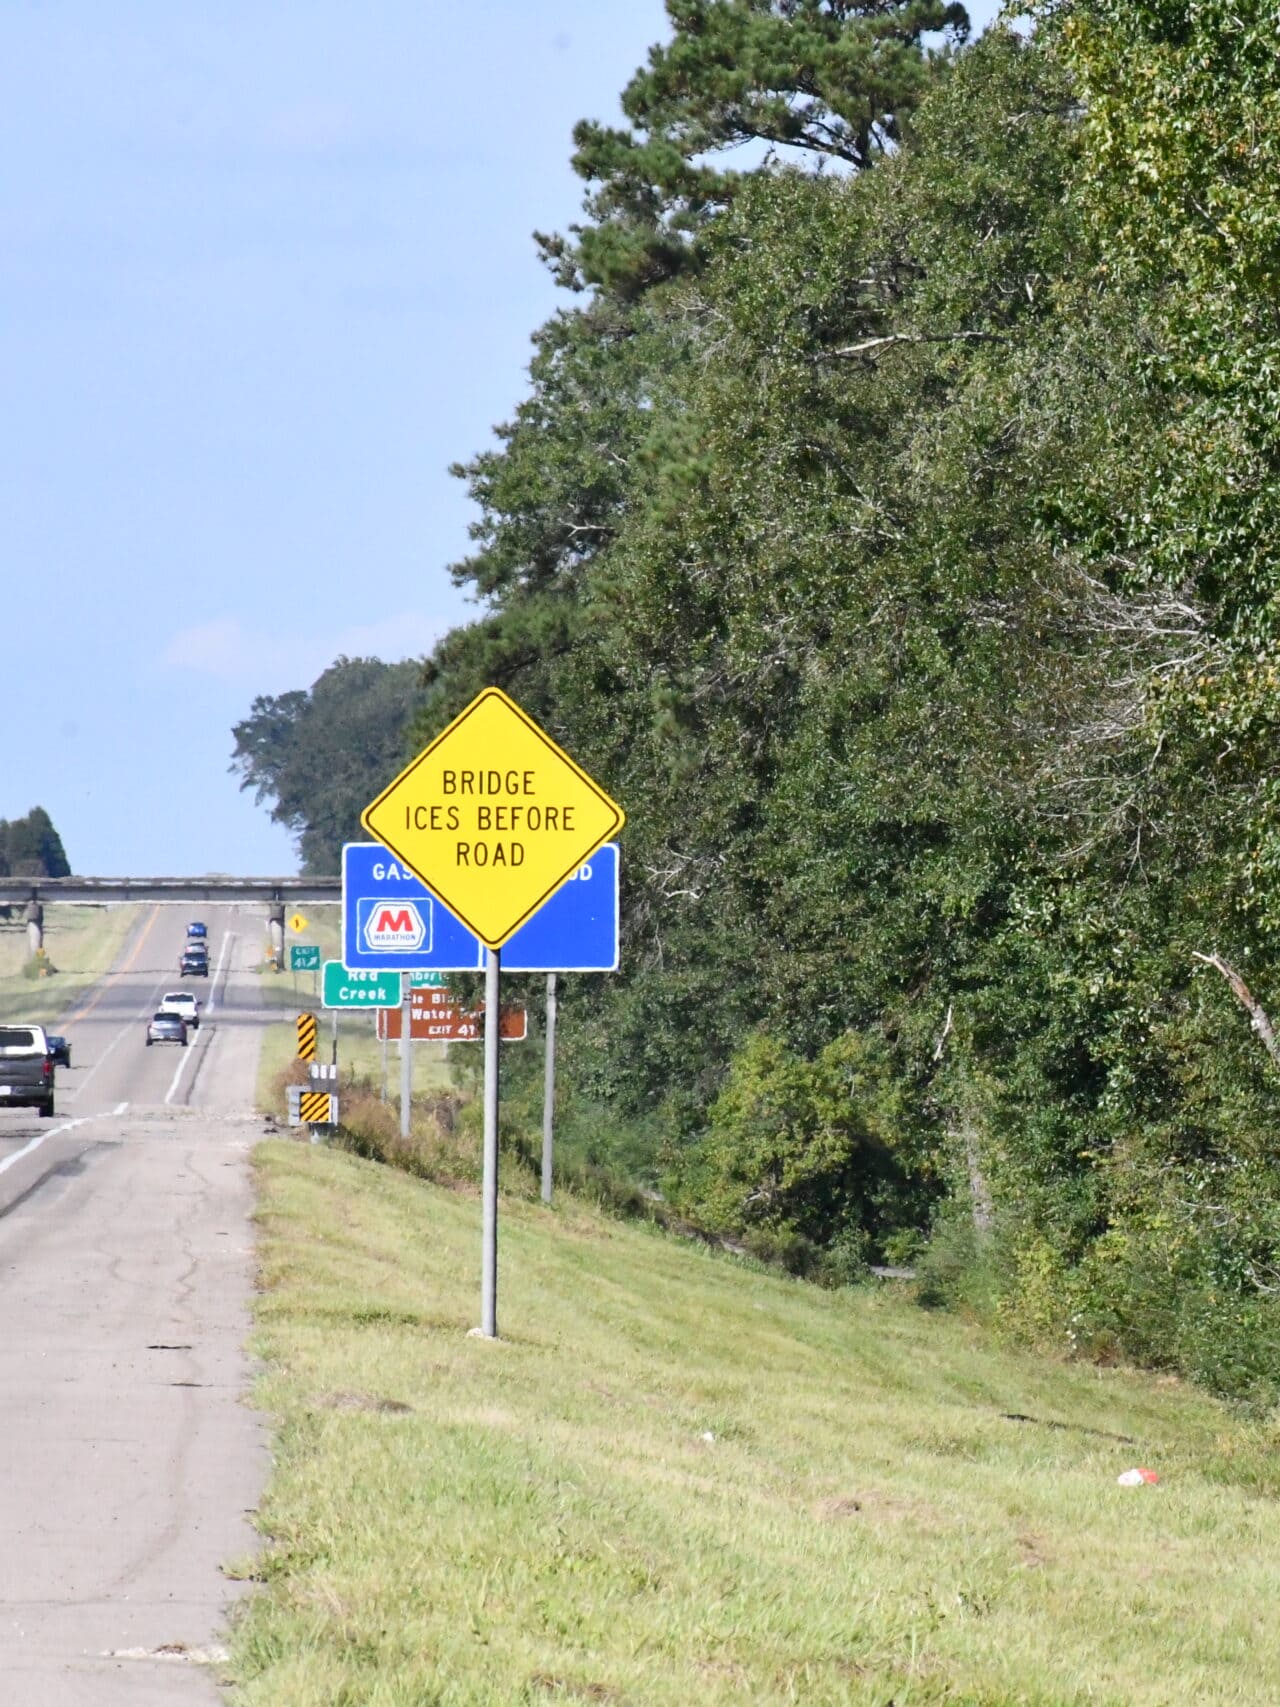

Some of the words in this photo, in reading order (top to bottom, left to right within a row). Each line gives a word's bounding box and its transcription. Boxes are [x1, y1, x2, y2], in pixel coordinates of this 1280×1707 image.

[443, 771, 536, 795] BRIDGE
[406, 806, 460, 831] ICES
[477, 806, 575, 831] BEFORE
[456, 842, 525, 866] ROAD
[373, 863, 413, 881] GAS
[376, 910, 413, 932] M
[295, 947, 315, 955] EXIT
[339, 987, 386, 1000] Creek
[412, 1008, 453, 1020] Water
[428, 1025, 453, 1034] EXIT
[457, 1024, 475, 1036] 41
